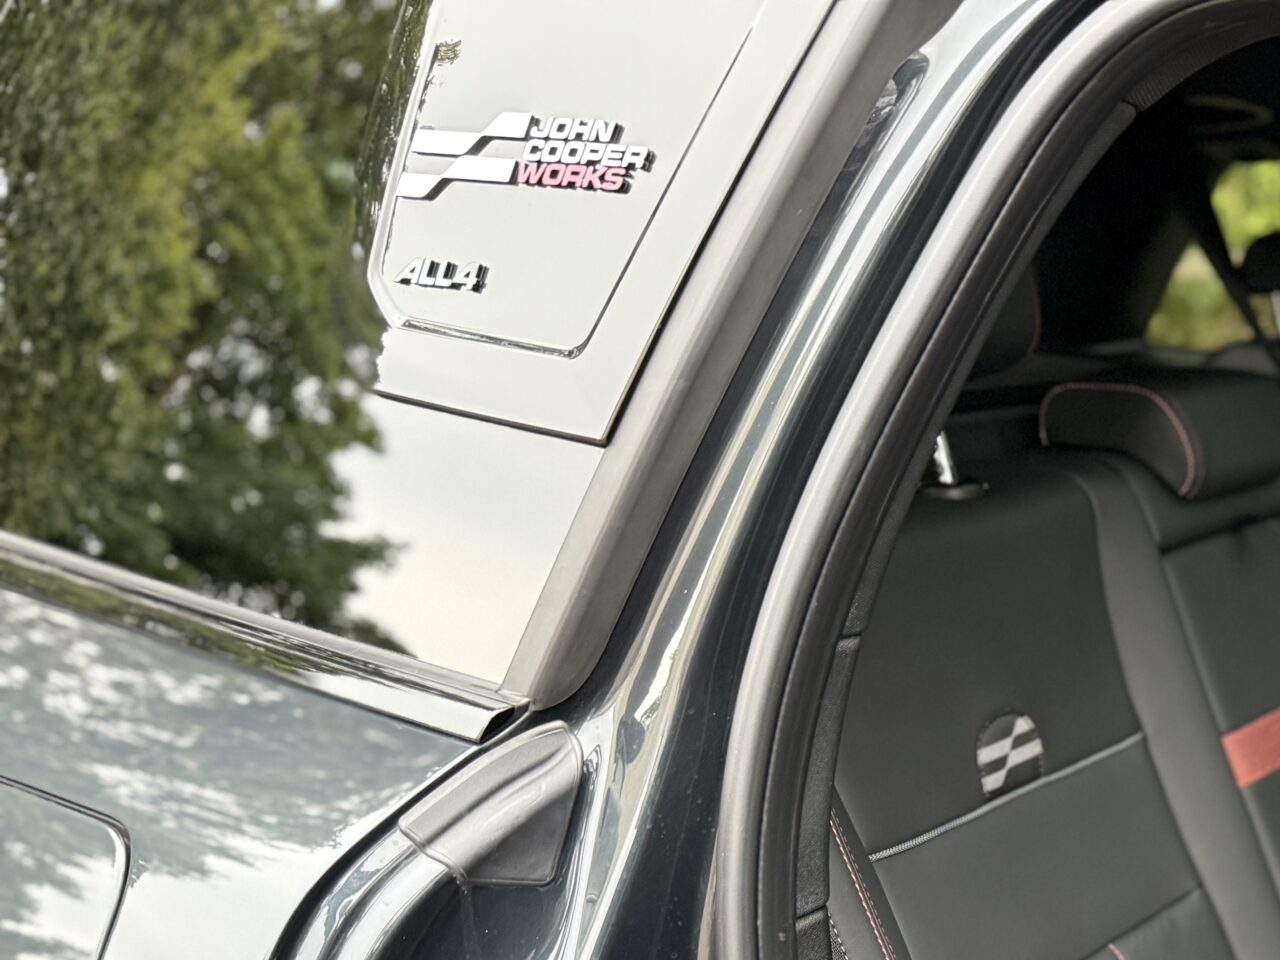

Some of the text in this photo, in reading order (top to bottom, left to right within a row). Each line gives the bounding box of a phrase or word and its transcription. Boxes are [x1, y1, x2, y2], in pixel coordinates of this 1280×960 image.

[530, 116, 620, 143] JOHN
[523, 139, 650, 169] COOPER
[517, 163, 628, 191] WORKS
[394, 257, 486, 292] ALL4
